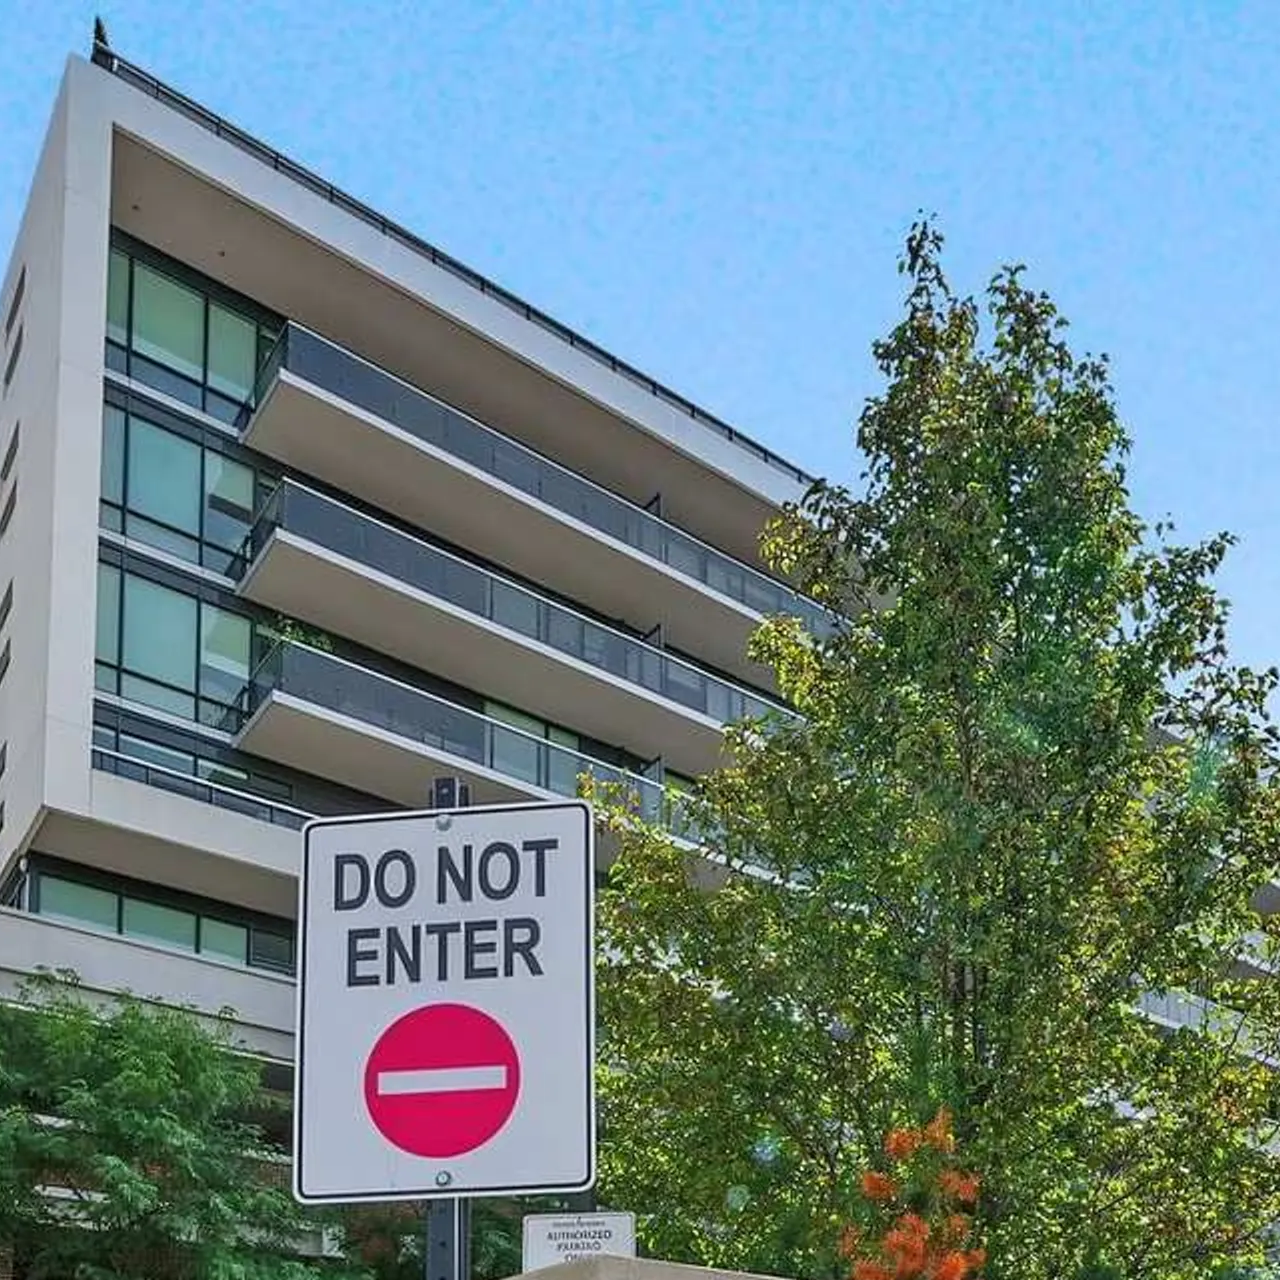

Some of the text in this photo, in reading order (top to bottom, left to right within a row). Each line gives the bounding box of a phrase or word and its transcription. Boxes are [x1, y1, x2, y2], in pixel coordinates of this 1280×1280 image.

[333, 838, 559, 911] DO NOT
[346, 917, 544, 988] ENTER
